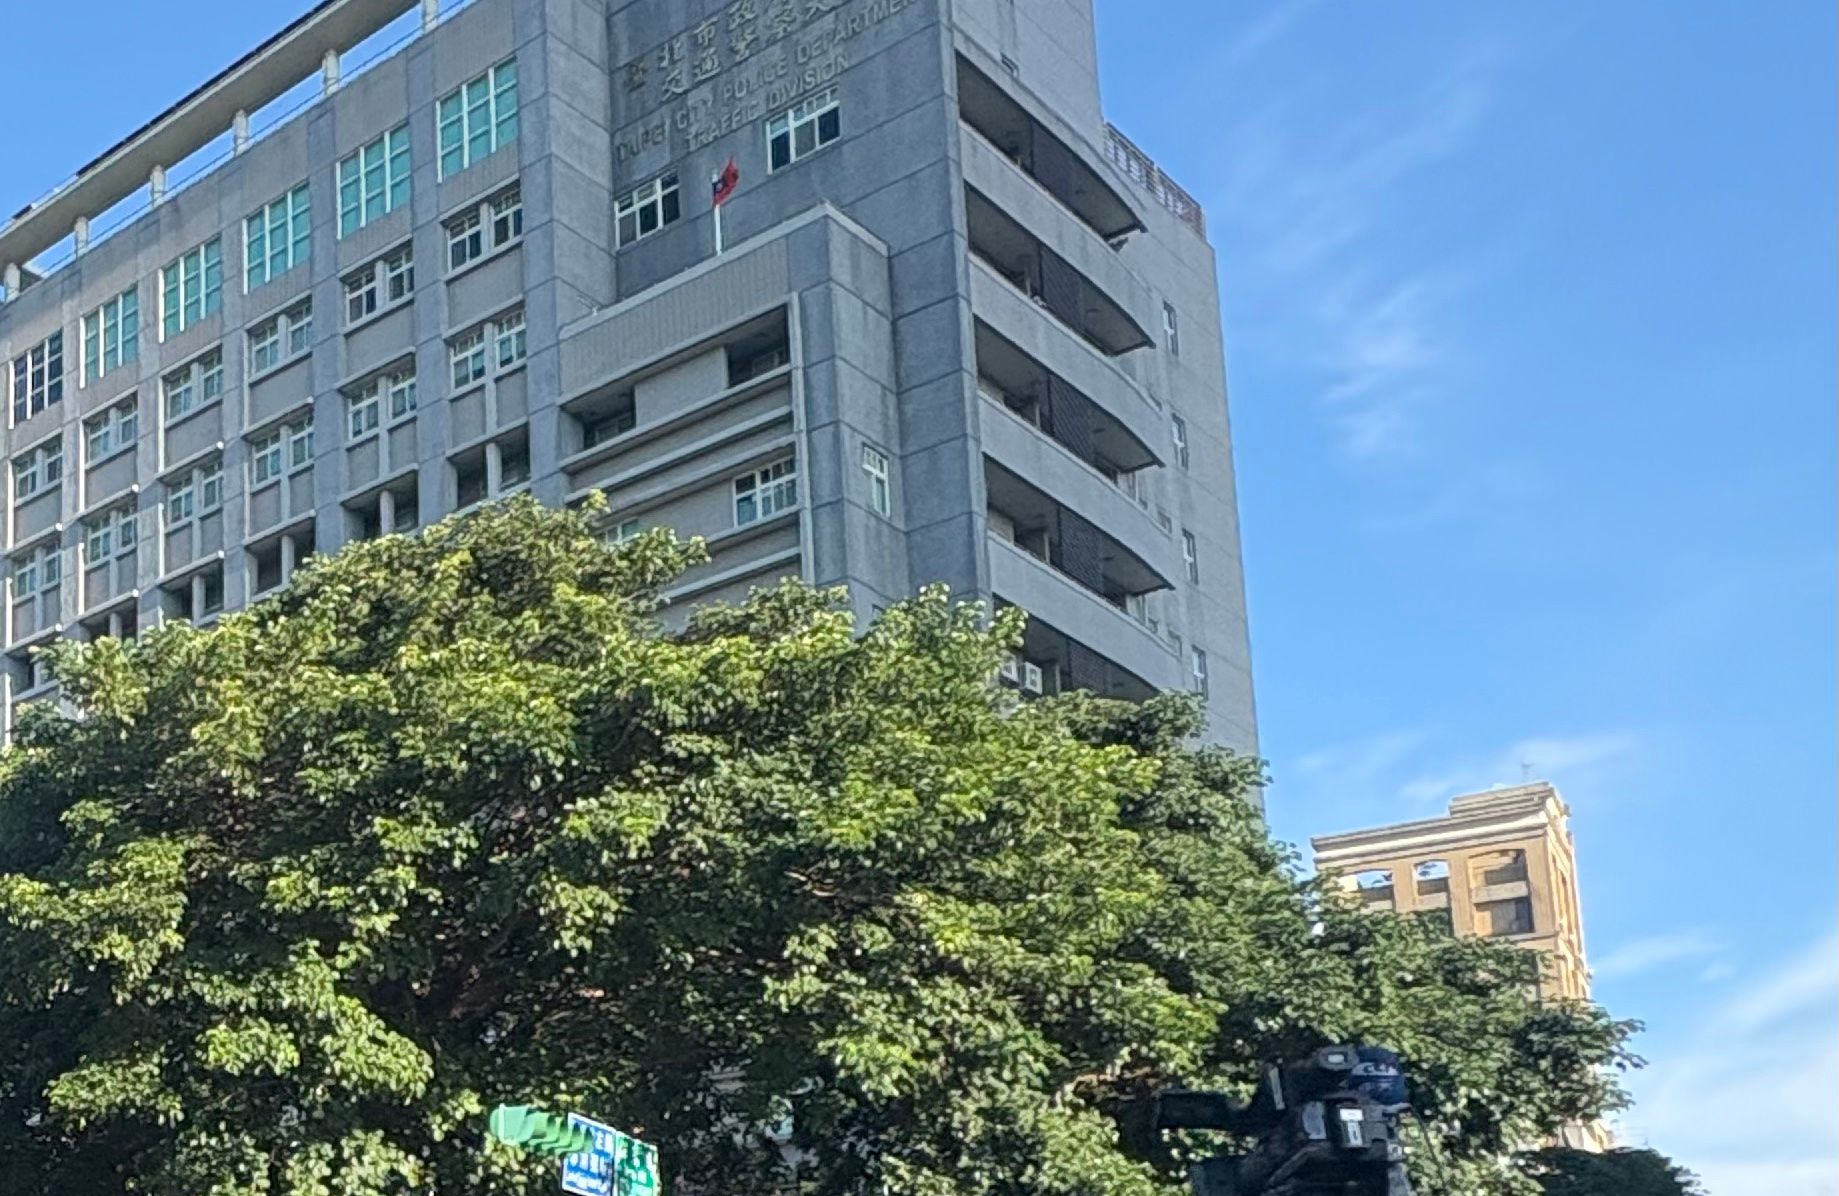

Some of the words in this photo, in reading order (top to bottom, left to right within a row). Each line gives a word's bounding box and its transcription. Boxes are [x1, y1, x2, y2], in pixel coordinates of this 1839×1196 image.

[677, 94, 714, 129] CITY
[723, 56, 787, 101] POLICE
[686, 100, 758, 152] TRAFFIC
[769, 52, 849, 108] DIVISION
